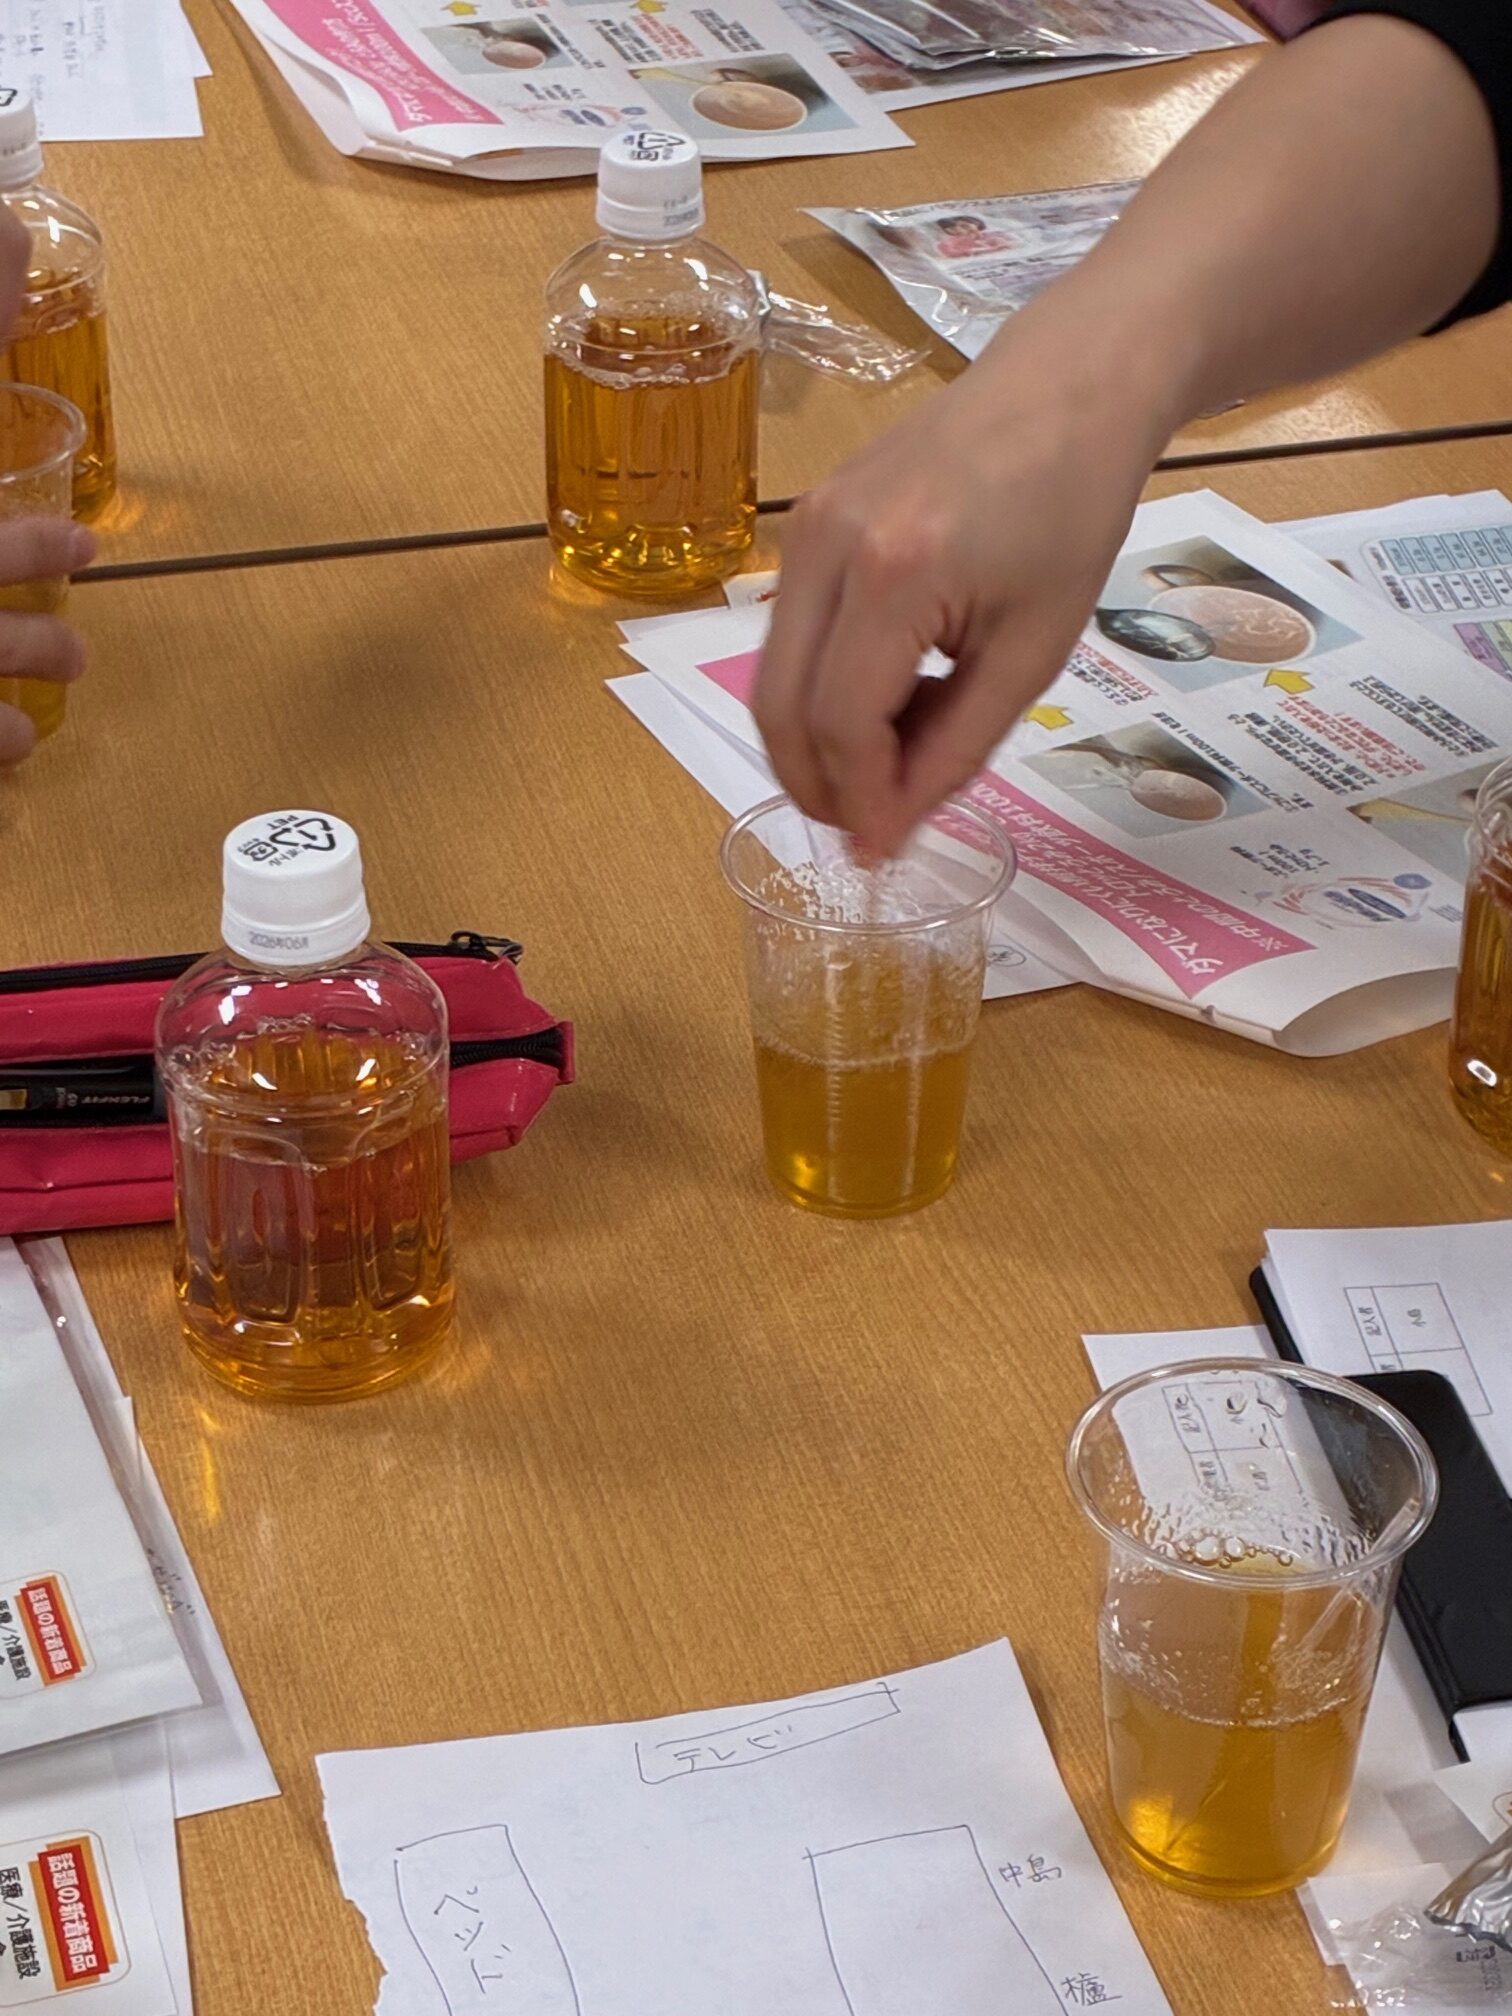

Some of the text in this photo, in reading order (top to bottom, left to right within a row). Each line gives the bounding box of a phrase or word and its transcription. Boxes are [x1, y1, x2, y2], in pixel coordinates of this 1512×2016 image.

[267, 815, 300, 829] PET
[27, 1587, 73, 1675] 話題の新着商品
[998, 1854, 1063, 1888] 中島
[47, 1852, 98, 1974] 話題の新着商品
